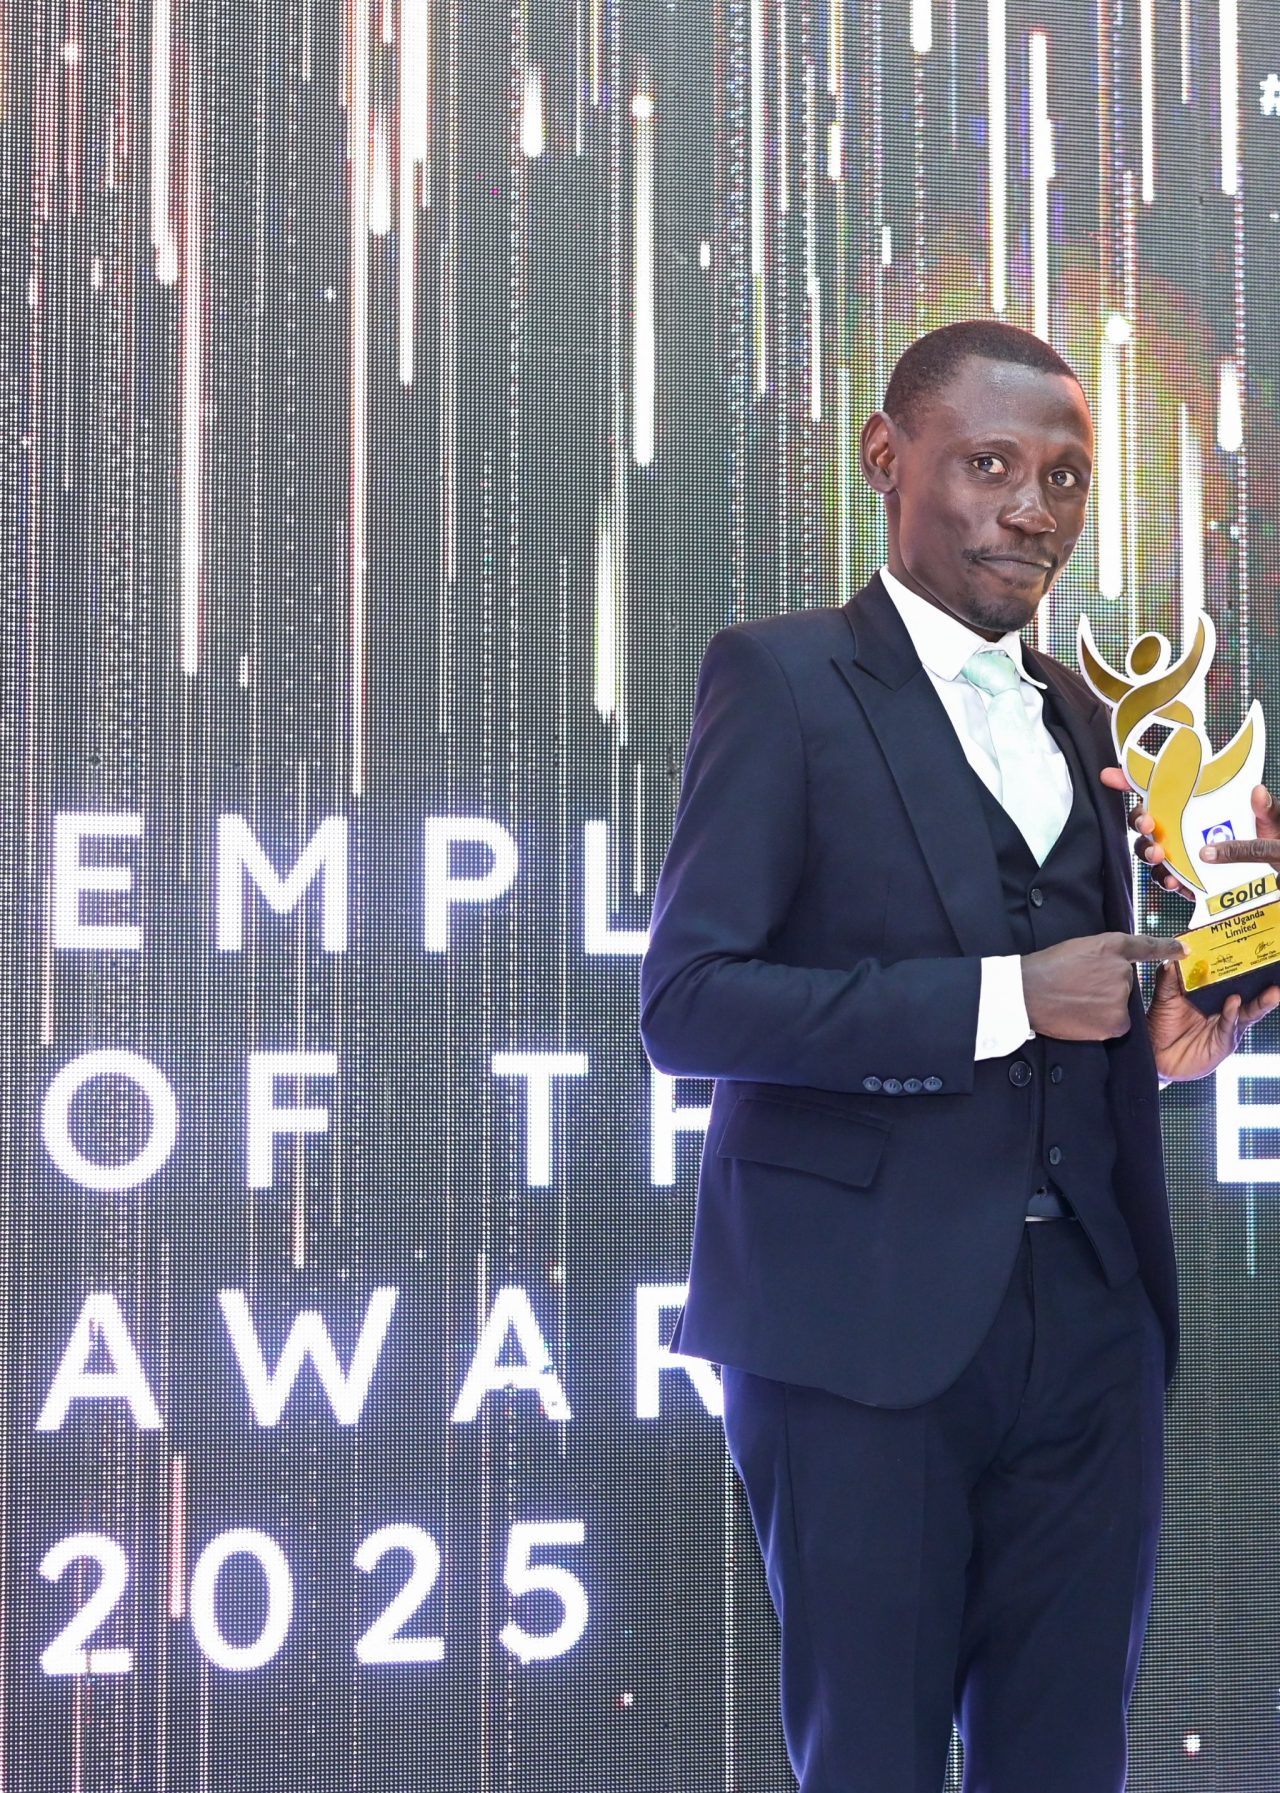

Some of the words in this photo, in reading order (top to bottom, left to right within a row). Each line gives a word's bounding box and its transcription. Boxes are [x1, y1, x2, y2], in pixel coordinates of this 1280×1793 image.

[1219, 877, 1267, 909] Gold
[1210, 919, 1232, 934] MTN
[1232, 909, 1265, 926] Uganda
[1225, 922, 1257, 939] Limited
[41, 1049, 338, 1190] OF
[37, 1520, 590, 1675] 2025
